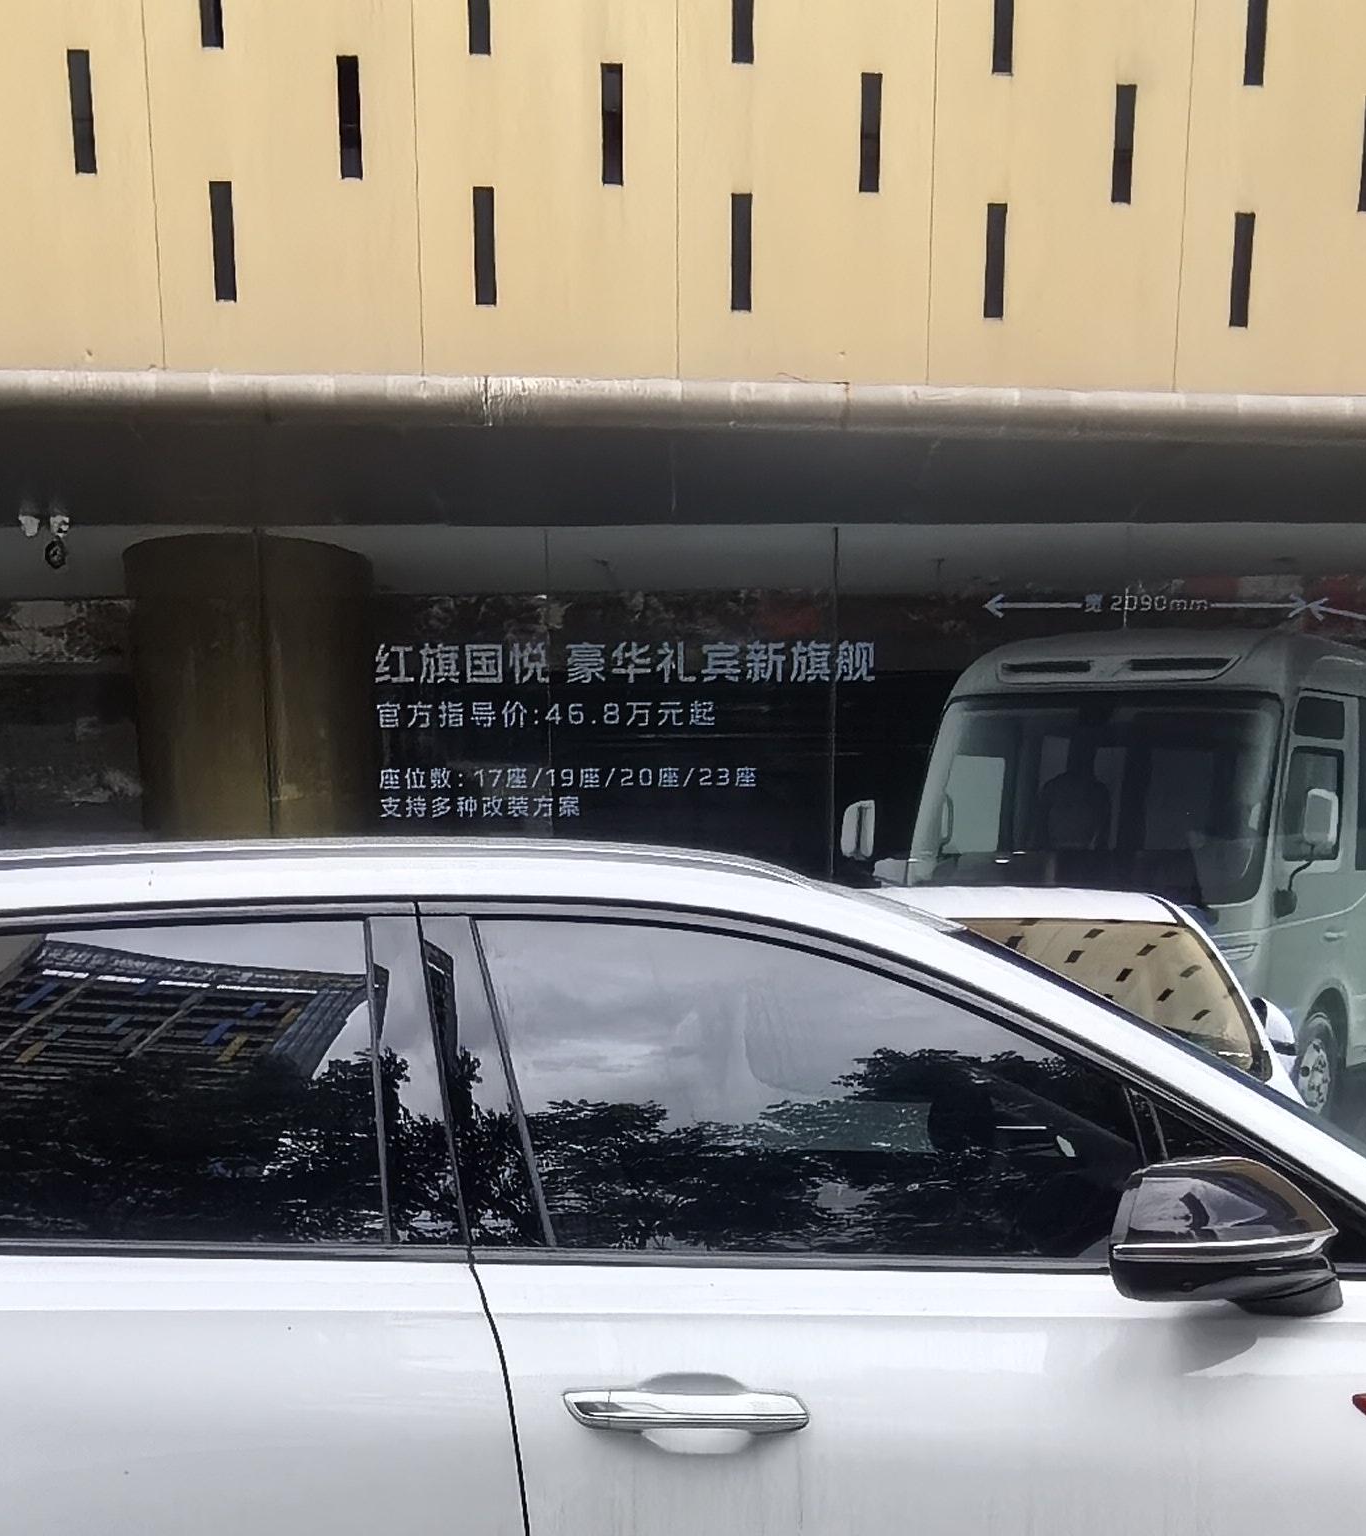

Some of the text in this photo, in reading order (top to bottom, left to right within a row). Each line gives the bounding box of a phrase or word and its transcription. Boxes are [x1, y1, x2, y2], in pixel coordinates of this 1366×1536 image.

[1110, 595, 1209, 612] 2090mm
[374, 640, 876, 684] 红旗国悦 豪华礼宾新旗舰
[380, 796, 581, 818] 支持多种改装方案
